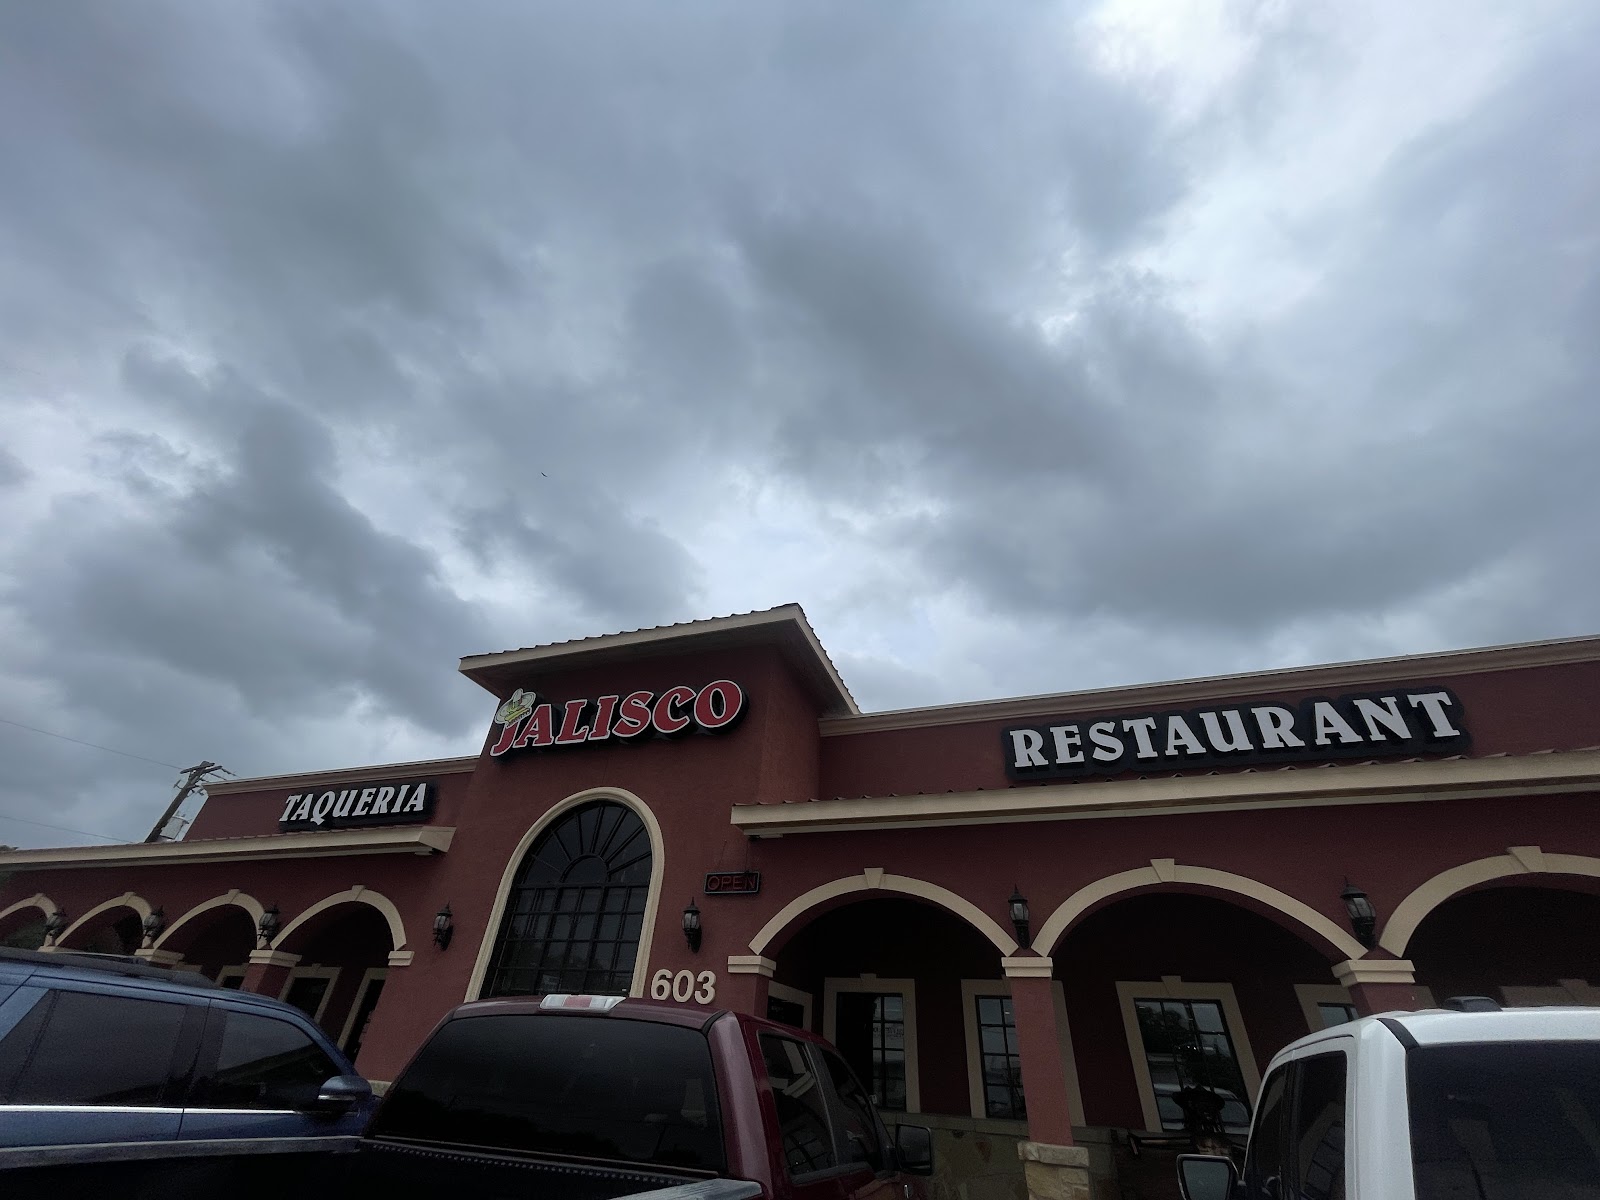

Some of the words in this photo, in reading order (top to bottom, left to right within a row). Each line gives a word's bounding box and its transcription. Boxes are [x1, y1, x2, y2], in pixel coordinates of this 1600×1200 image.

[490, 680, 743, 756] JALISCO
[1010, 692, 1460, 768] RESTAURANT
[279, 783, 427, 825] TAQUERIA
[707, 874, 756, 891] OPEN
[650, 968, 717, 1005] 603
